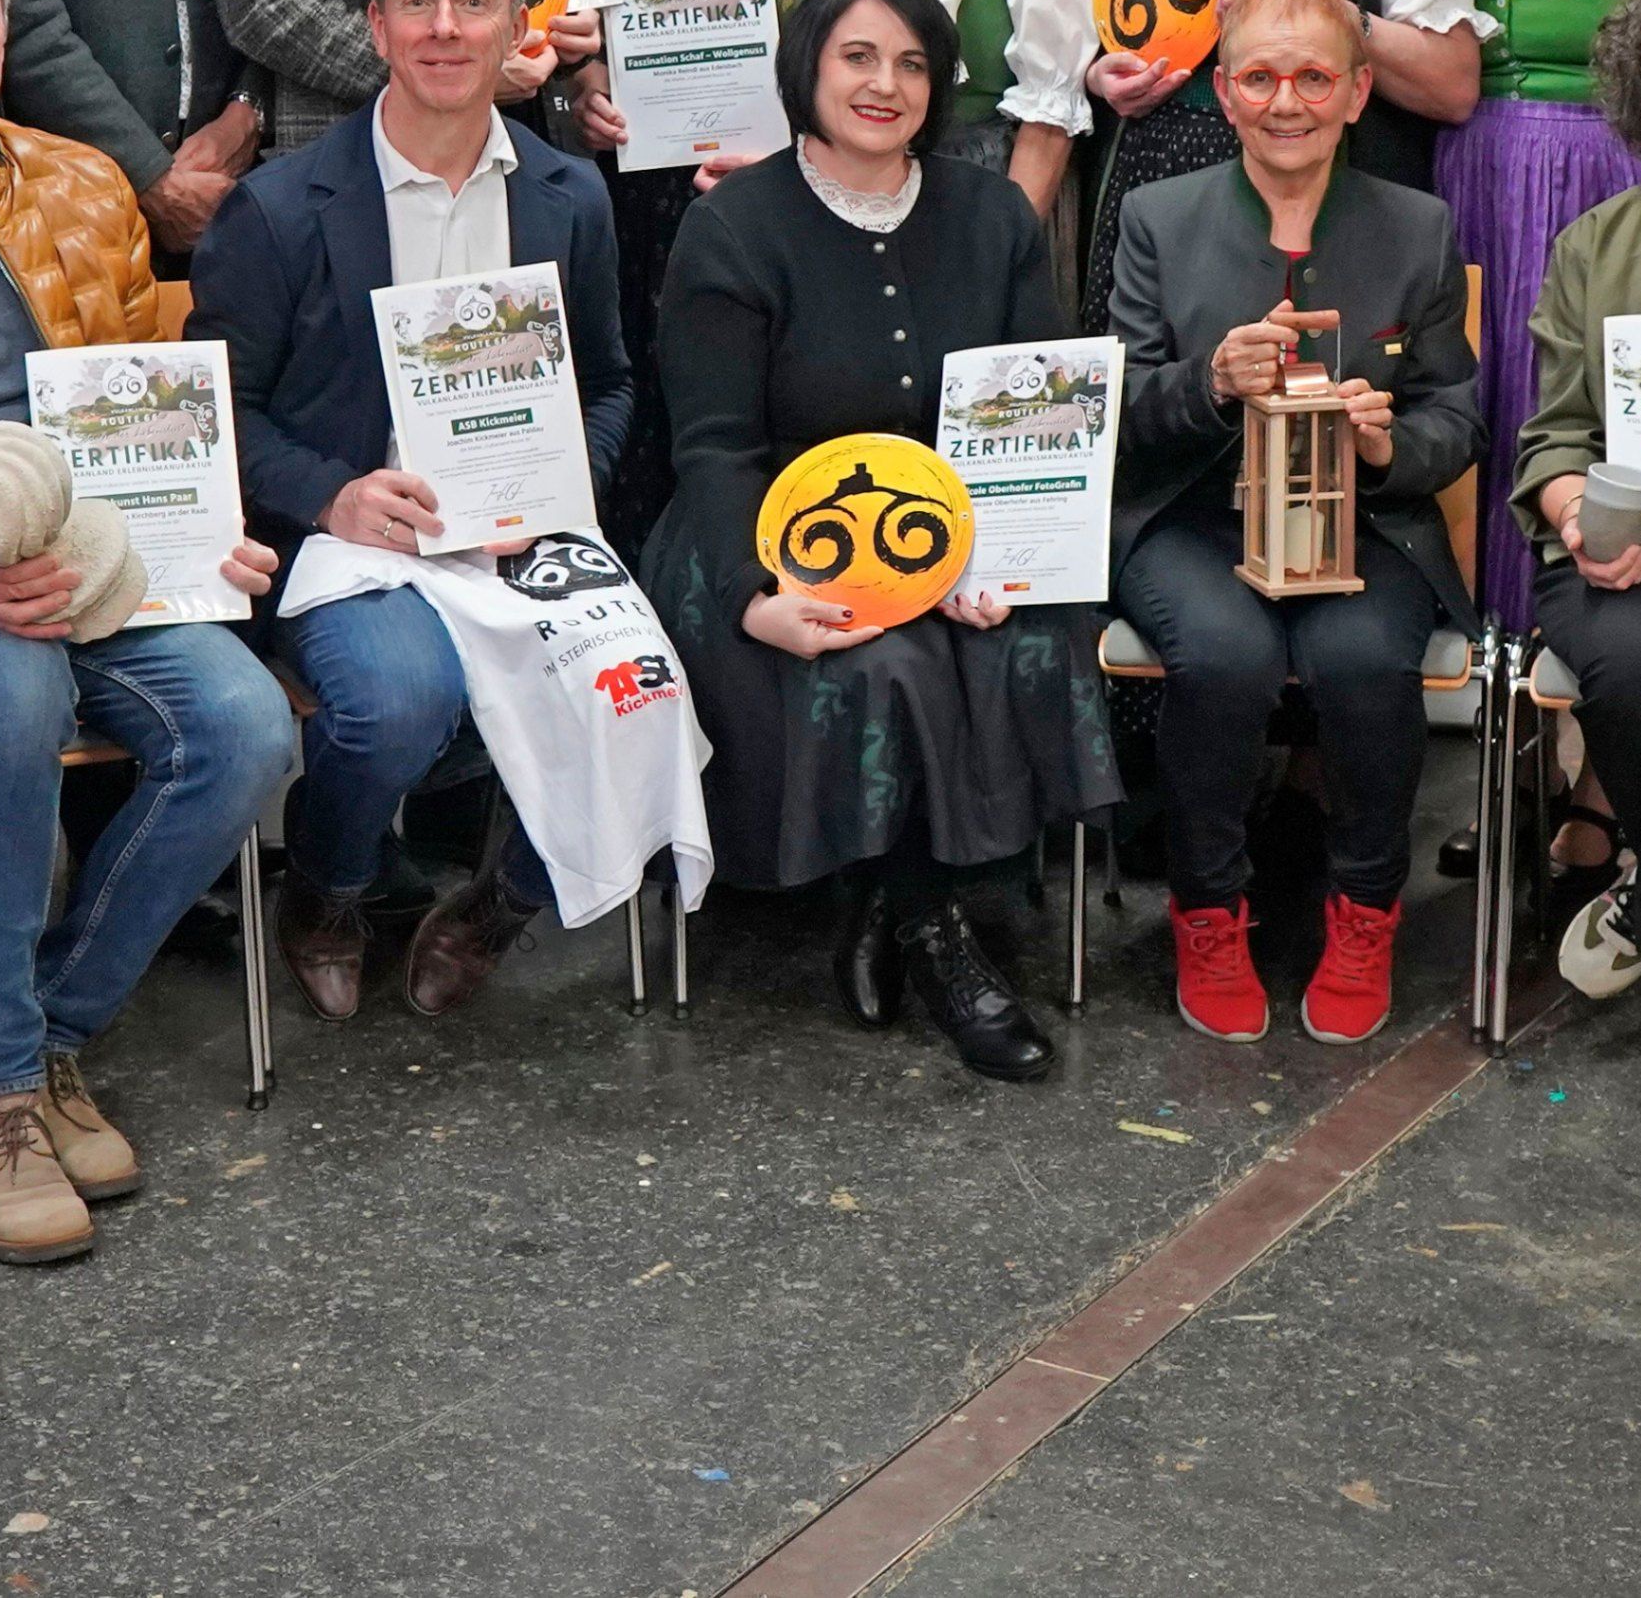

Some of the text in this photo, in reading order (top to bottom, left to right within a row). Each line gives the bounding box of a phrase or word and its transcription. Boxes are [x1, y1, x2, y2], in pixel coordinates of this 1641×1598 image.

[622, 2, 762, 32] ZERTIFIKAT
[626, 28, 675, 40] VULKANLAND
[628, 54, 678, 68] Faszination
[680, 50, 705, 63] Schaf
[712, 46, 764, 59] Wollgenuss
[454, 340, 491, 352] ROUTE
[411, 358, 559, 398] ZERTIFIKAT
[416, 392, 470, 406] VULKANLAND
[471, 379, 559, 399] ERLEBNISMANUFAKTUR
[100, 415, 141, 427] ROUTE
[458, 412, 528, 431] ASB Kickmeier
[998, 408, 1034, 419] ROUTE
[950, 431, 1097, 458] ZERTIFIKAT
[71, 441, 212, 469] ERTIFIKAT
[74, 461, 213, 478] KANLAND ERLEBNISMANUFAKTUR
[988, 483, 1033, 494] Oberhofer
[1034, 479, 1082, 490] FotoGrafin
[142, 494, 168, 504] Hans
[170, 493, 193, 503] Paar
[543, 660, 558, 678] IM
[559, 626, 642, 668] STEIRISCHEN
[615, 686, 683, 717] Kickme
